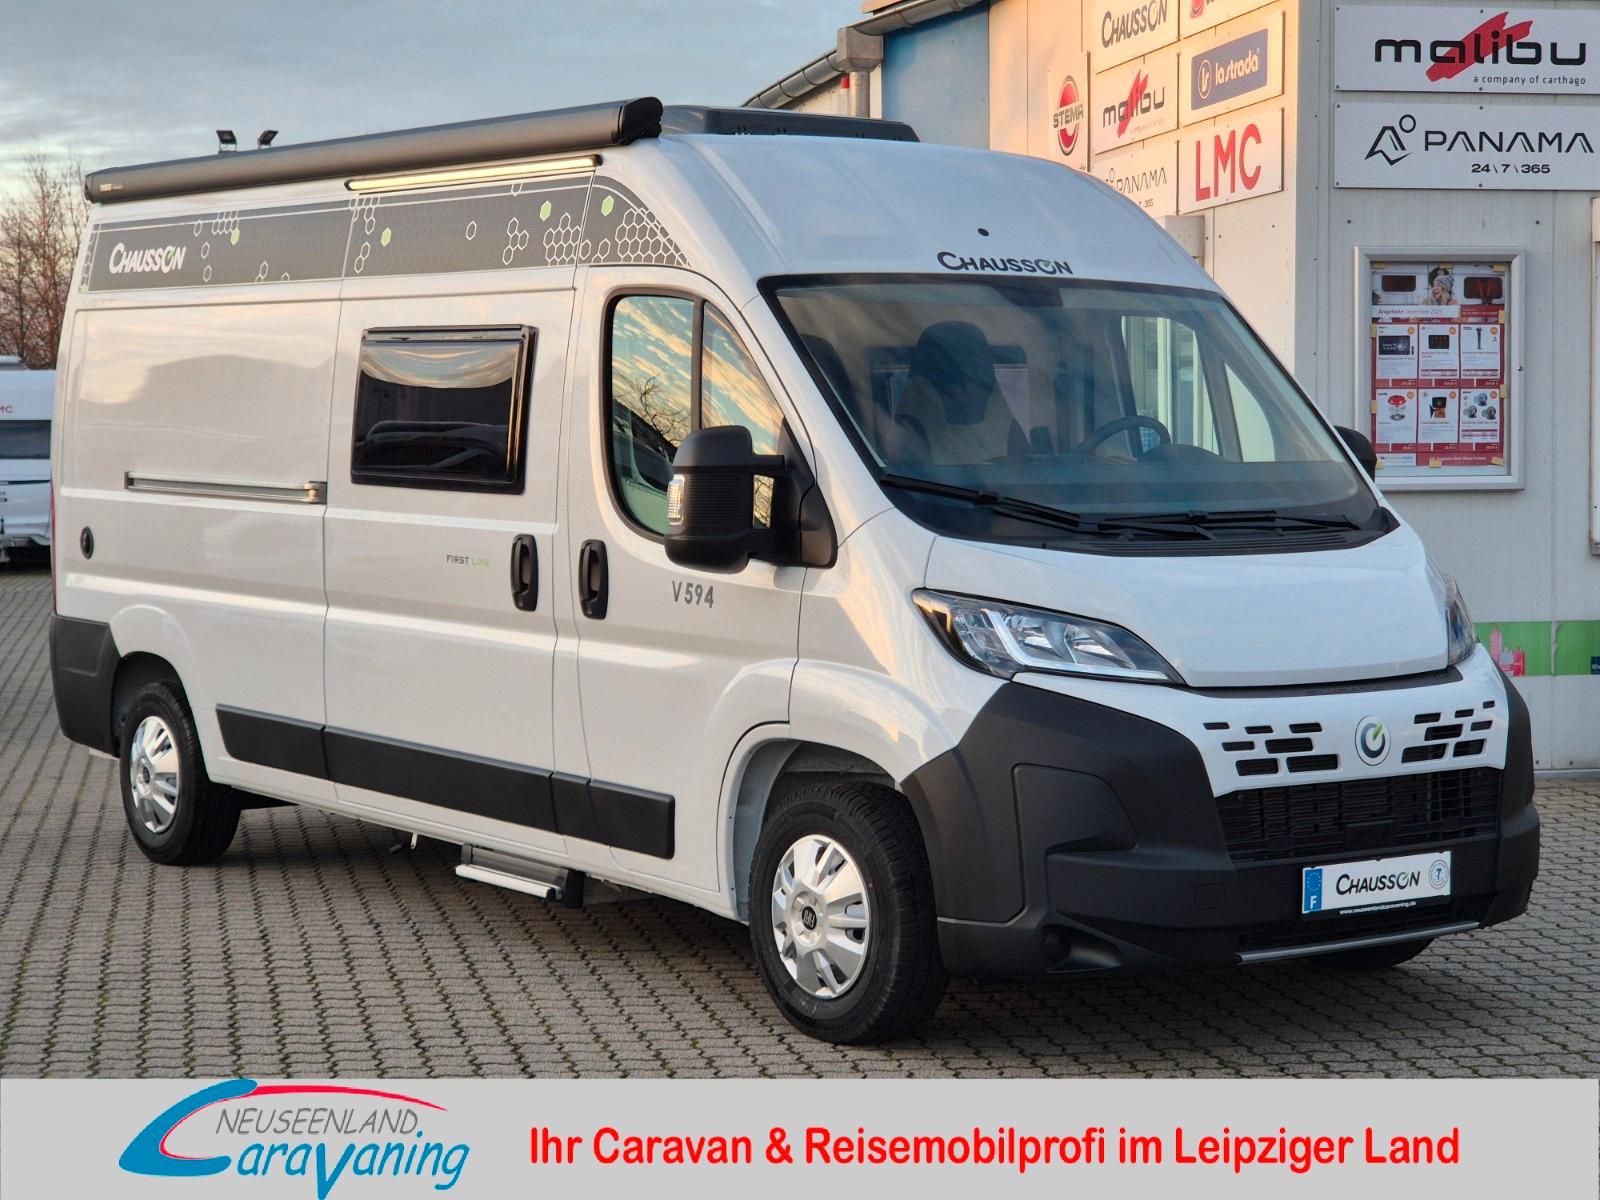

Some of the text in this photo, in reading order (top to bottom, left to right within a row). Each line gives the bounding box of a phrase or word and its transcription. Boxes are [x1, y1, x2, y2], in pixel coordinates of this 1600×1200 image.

[1102, 0, 1167, 48] CHAUSSON
[1374, 30, 1586, 66] malibu
[1473, 75, 1586, 86] a company of carthago
[1053, 103, 1084, 129] STEMA
[1102, 85, 1165, 128] malibu
[1425, 130, 1594, 153] PANAMA
[1195, 123, 1262, 201] LMC
[1117, 167, 1167, 194] PANAMA
[109, 242, 187, 274] CHAUSSON
[937, 251, 1073, 275] CHAUSSON
[446, 555, 491, 567] FIRST LINE
[1336, 871, 1420, 896] CHAUSSON
[1310, 895, 1318, 909] F
